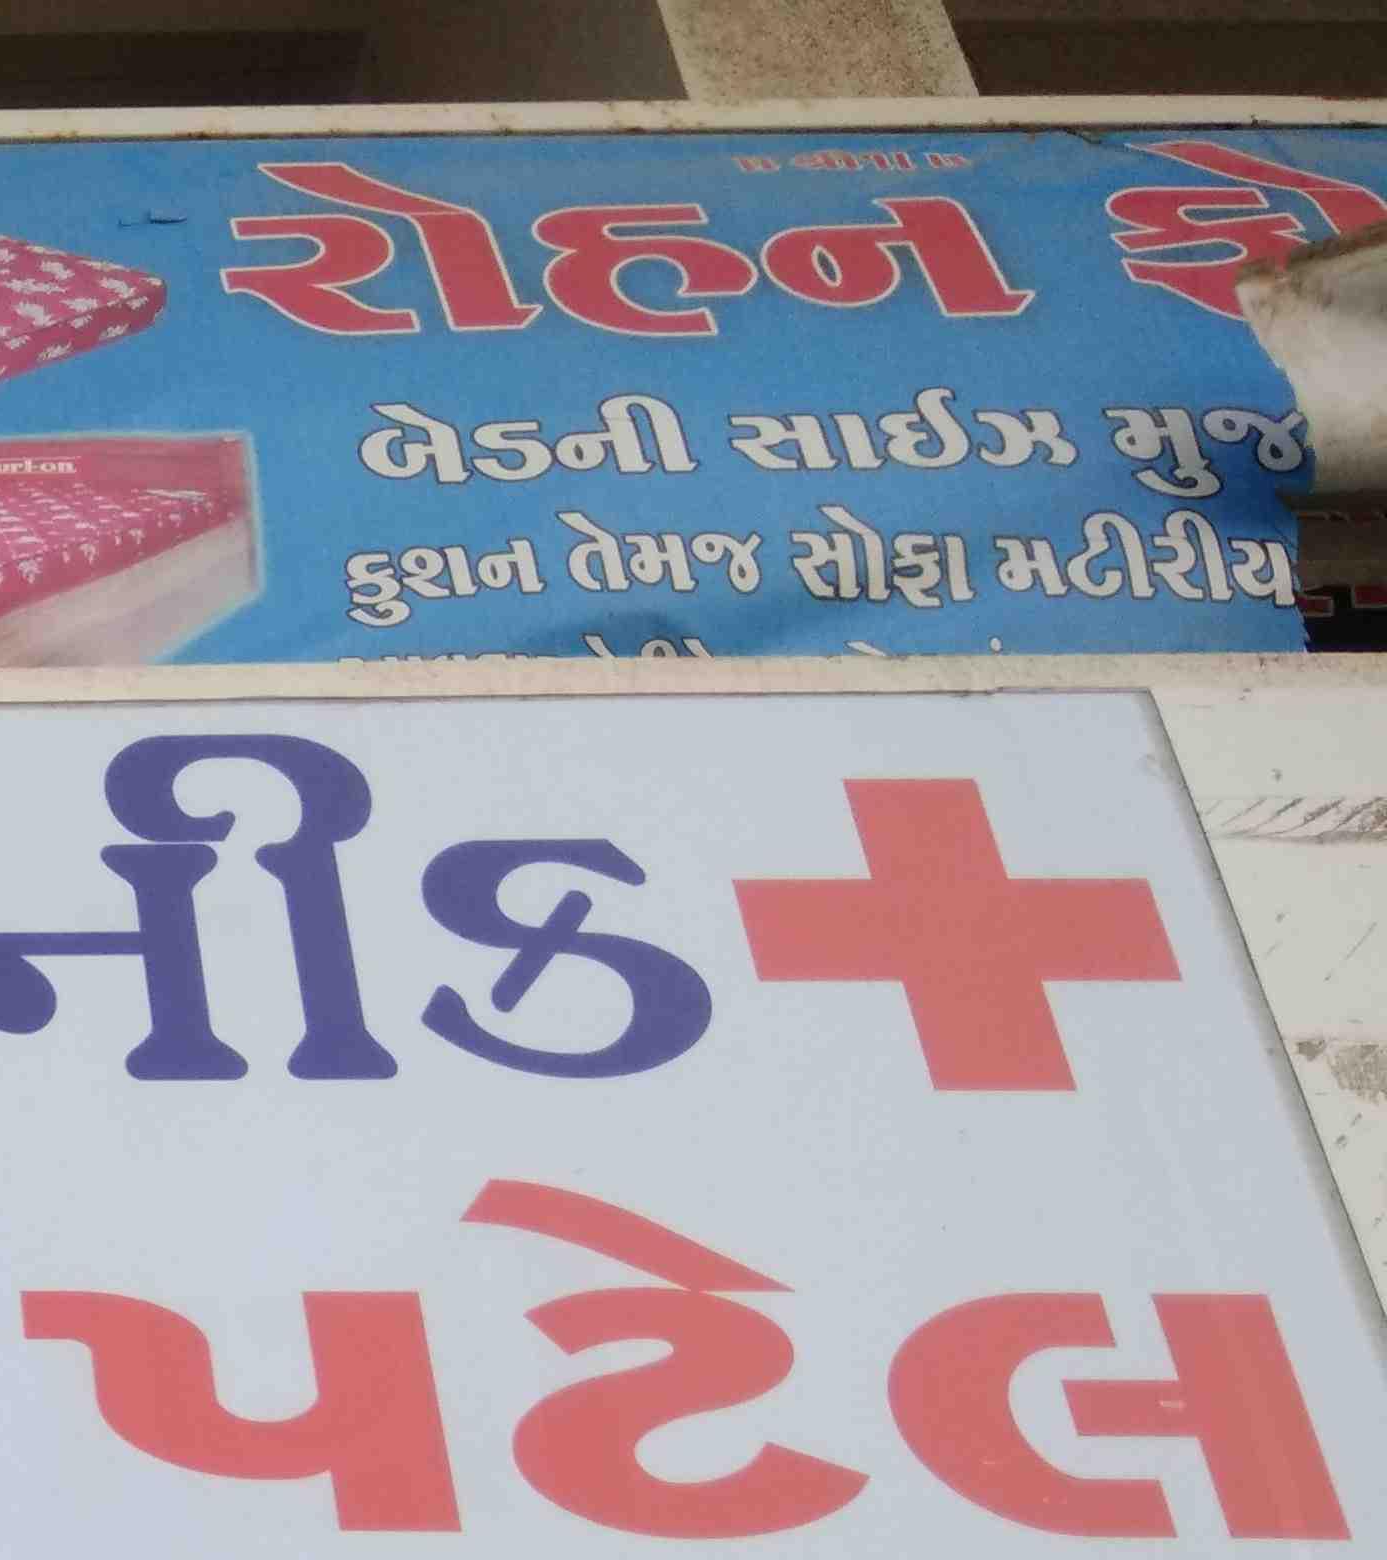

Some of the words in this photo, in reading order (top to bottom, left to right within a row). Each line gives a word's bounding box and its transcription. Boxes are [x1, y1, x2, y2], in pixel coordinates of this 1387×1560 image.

[221, 162, 1035, 336] રોહન
[357, 393, 700, 484] બેડની
[729, 387, 1079, 470] સાઈઝ
[344, 537, 546, 628] કુશન
[555, 509, 763, 595] તેમજ
[790, 504, 977, 608] સોફા
[19, 1178, 1352, 1541] પટેલ
